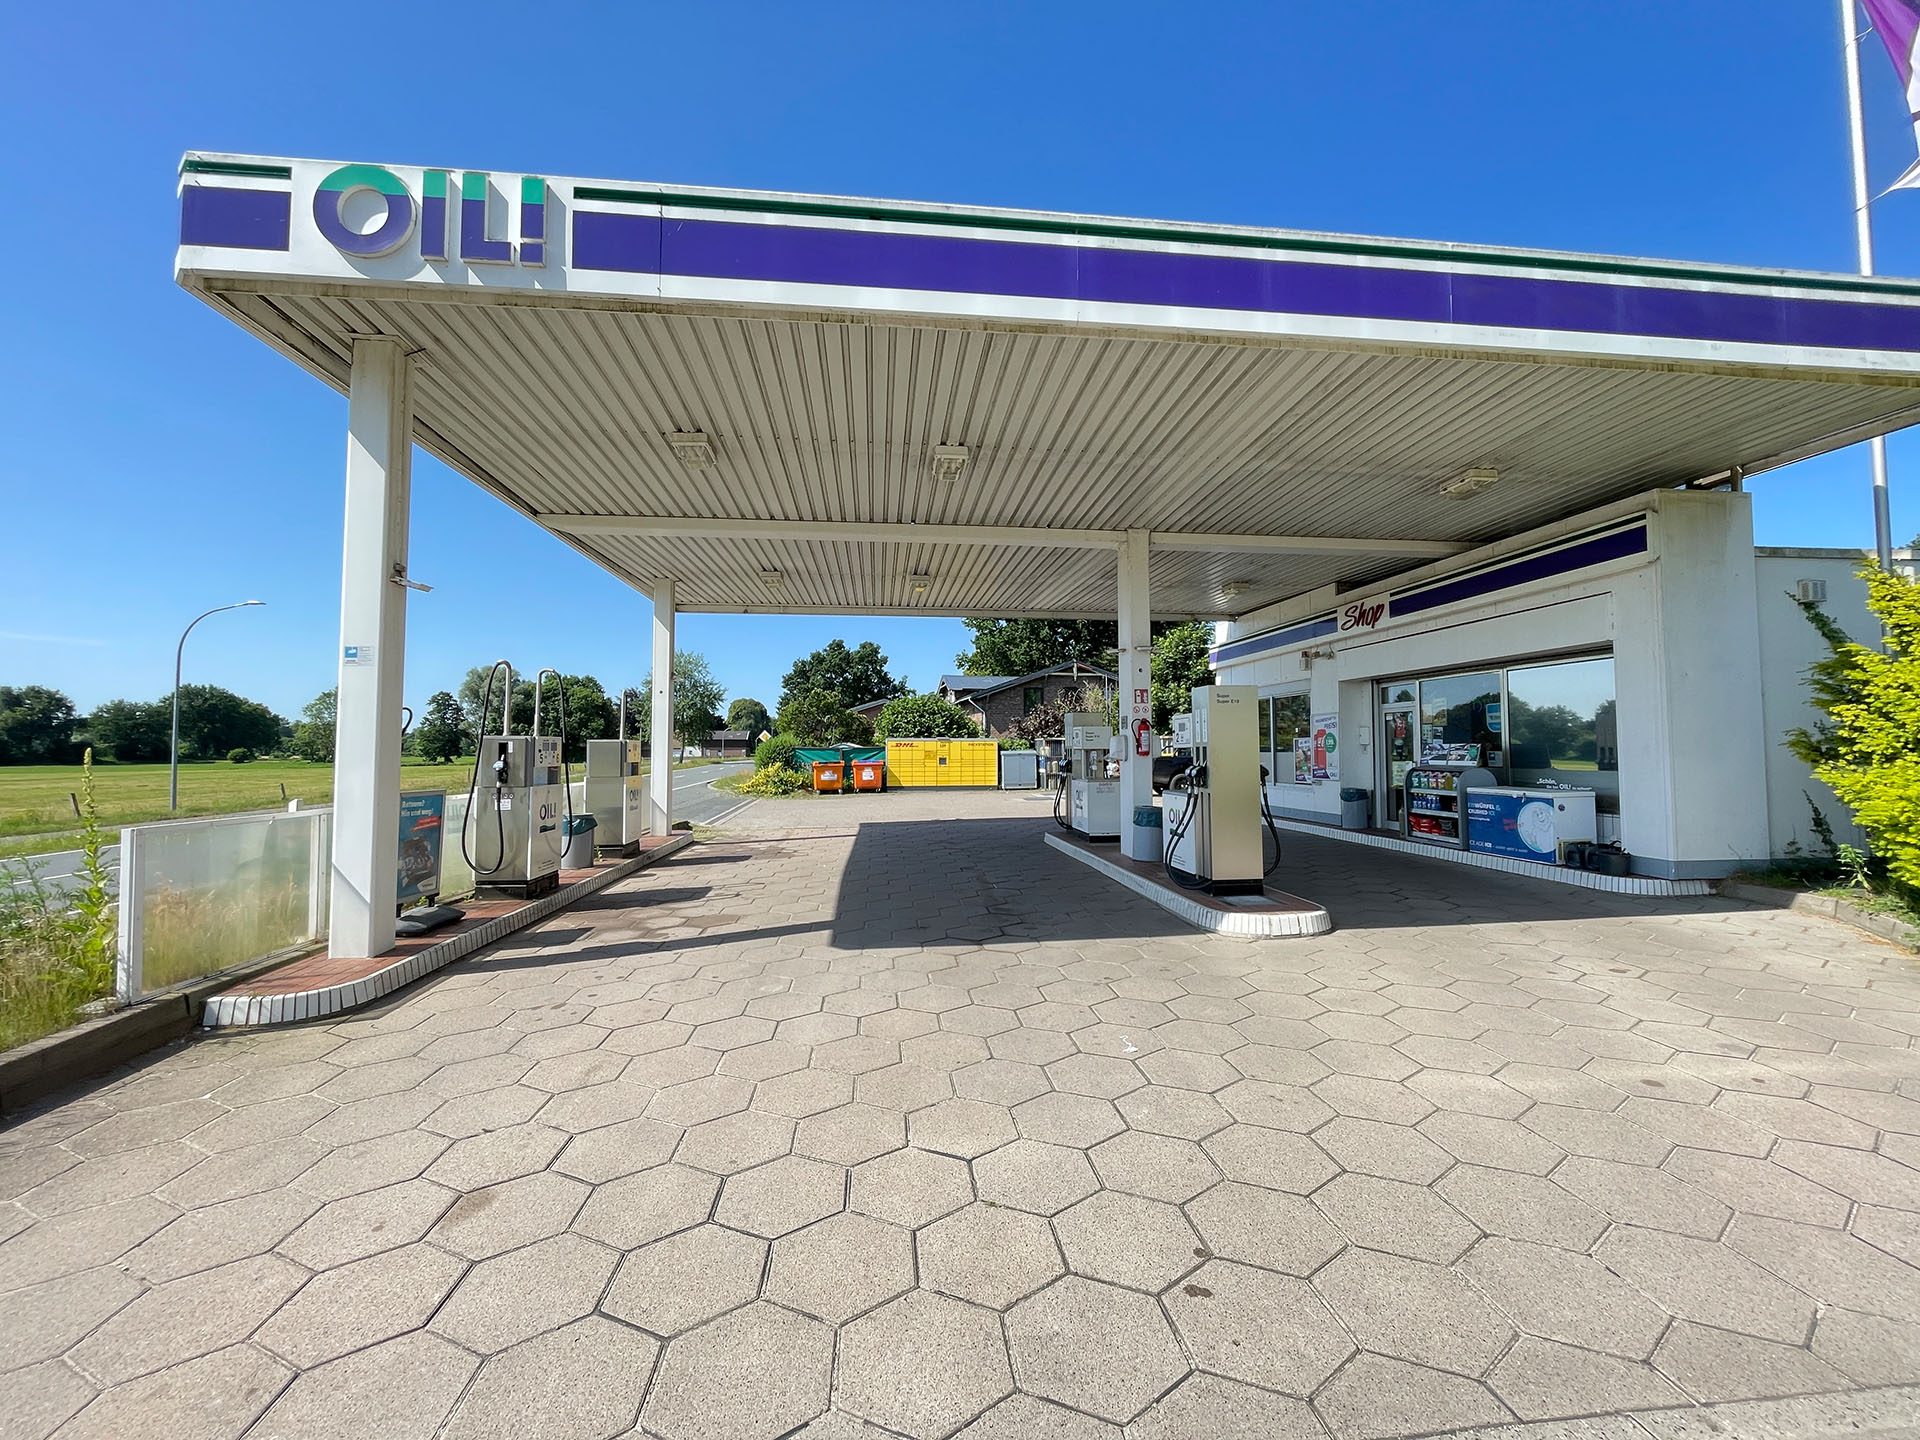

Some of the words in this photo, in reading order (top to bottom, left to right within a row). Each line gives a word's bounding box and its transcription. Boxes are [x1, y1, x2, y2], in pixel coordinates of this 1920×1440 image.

[313, 163, 547, 267] OIL!
[1341, 601, 1385, 631] Shop
[1175, 732, 1180, 743] 2
[539, 753, 544, 764] 5
[540, 802, 557, 821] OIL!
